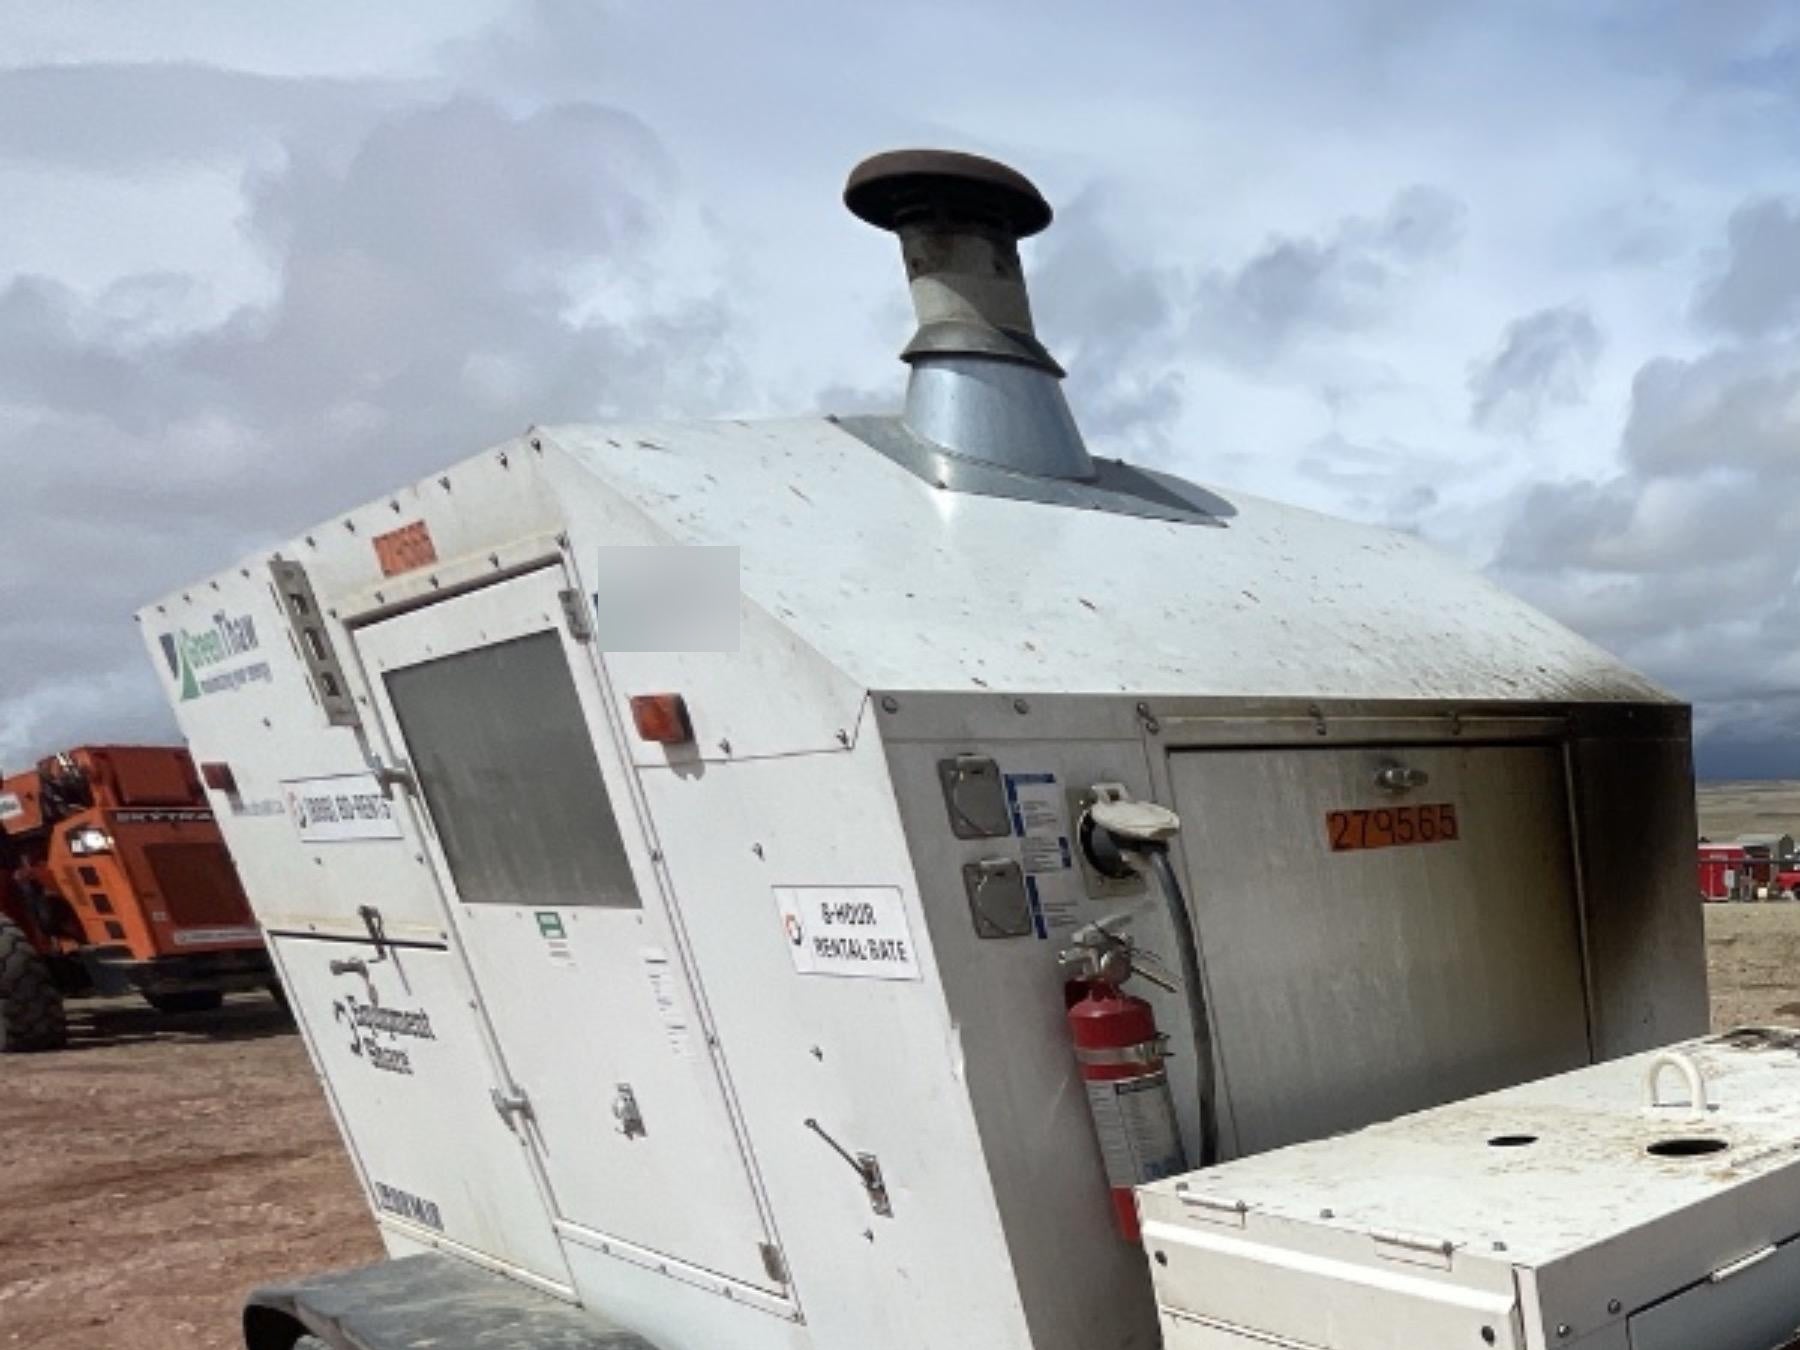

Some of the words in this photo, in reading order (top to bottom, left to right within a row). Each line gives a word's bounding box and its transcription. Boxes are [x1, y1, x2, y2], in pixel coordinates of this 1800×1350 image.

[115, 811, 211, 825] SKYTRA
[1328, 804, 1459, 850] 279565
[814, 936, 868, 961] RENTAL
[867, 937, 909, 962] RATE
